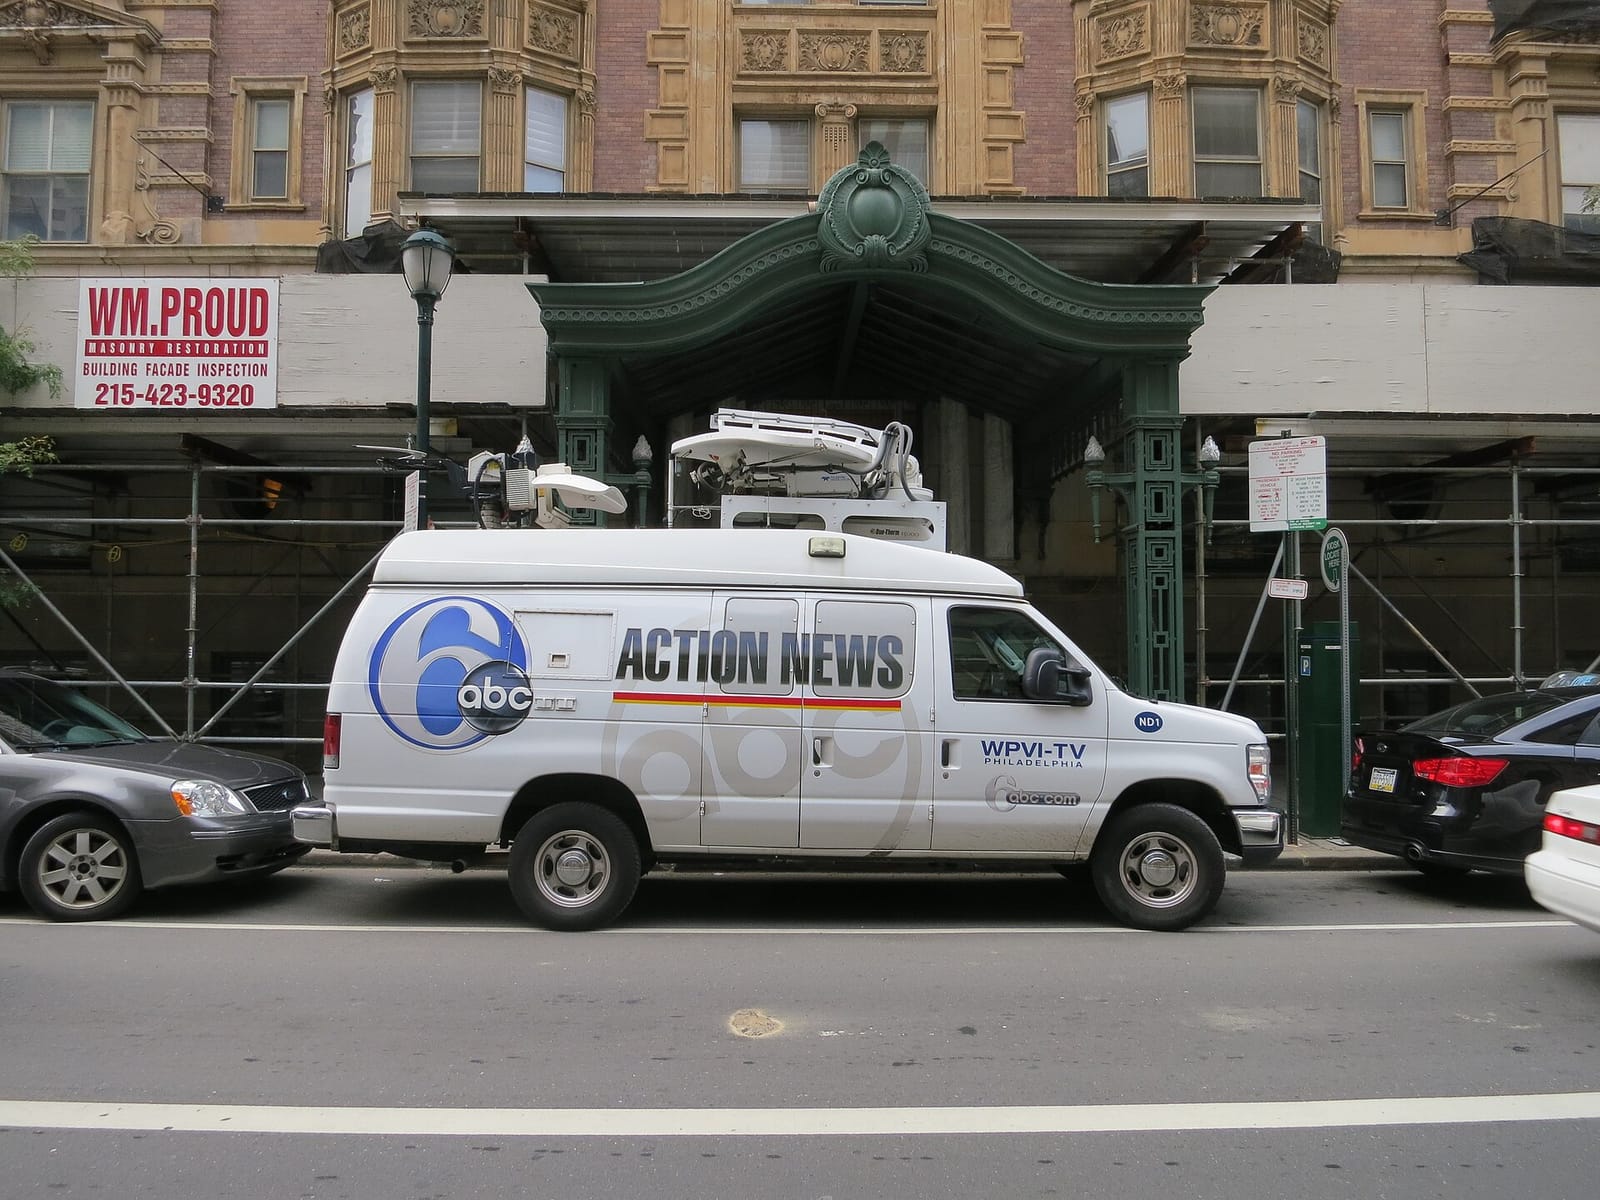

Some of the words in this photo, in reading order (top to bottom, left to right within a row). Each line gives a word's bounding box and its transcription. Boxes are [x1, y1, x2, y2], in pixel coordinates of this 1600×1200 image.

[88, 287, 269, 337] WM.PROUD
[88, 342, 155, 354] MASONRY
[166, 343, 265, 355] RESTORATION
[83, 362, 137, 376] BUILDING
[146, 363, 189, 376] FACADE
[198, 364, 268, 377] INSPECTION
[95, 383, 254, 406] 215-423-9320
[1327, 541, 1340, 551] KIOSK
[615, 628, 769, 684] ACTION
[780, 631, 904, 690] NEWS
[457, 676, 533, 711] abc
[1139, 717, 1160, 727] ND1
[981, 740, 1087, 760] WPVI-TV
[984, 758, 1083, 768] PHILADELPHIA
